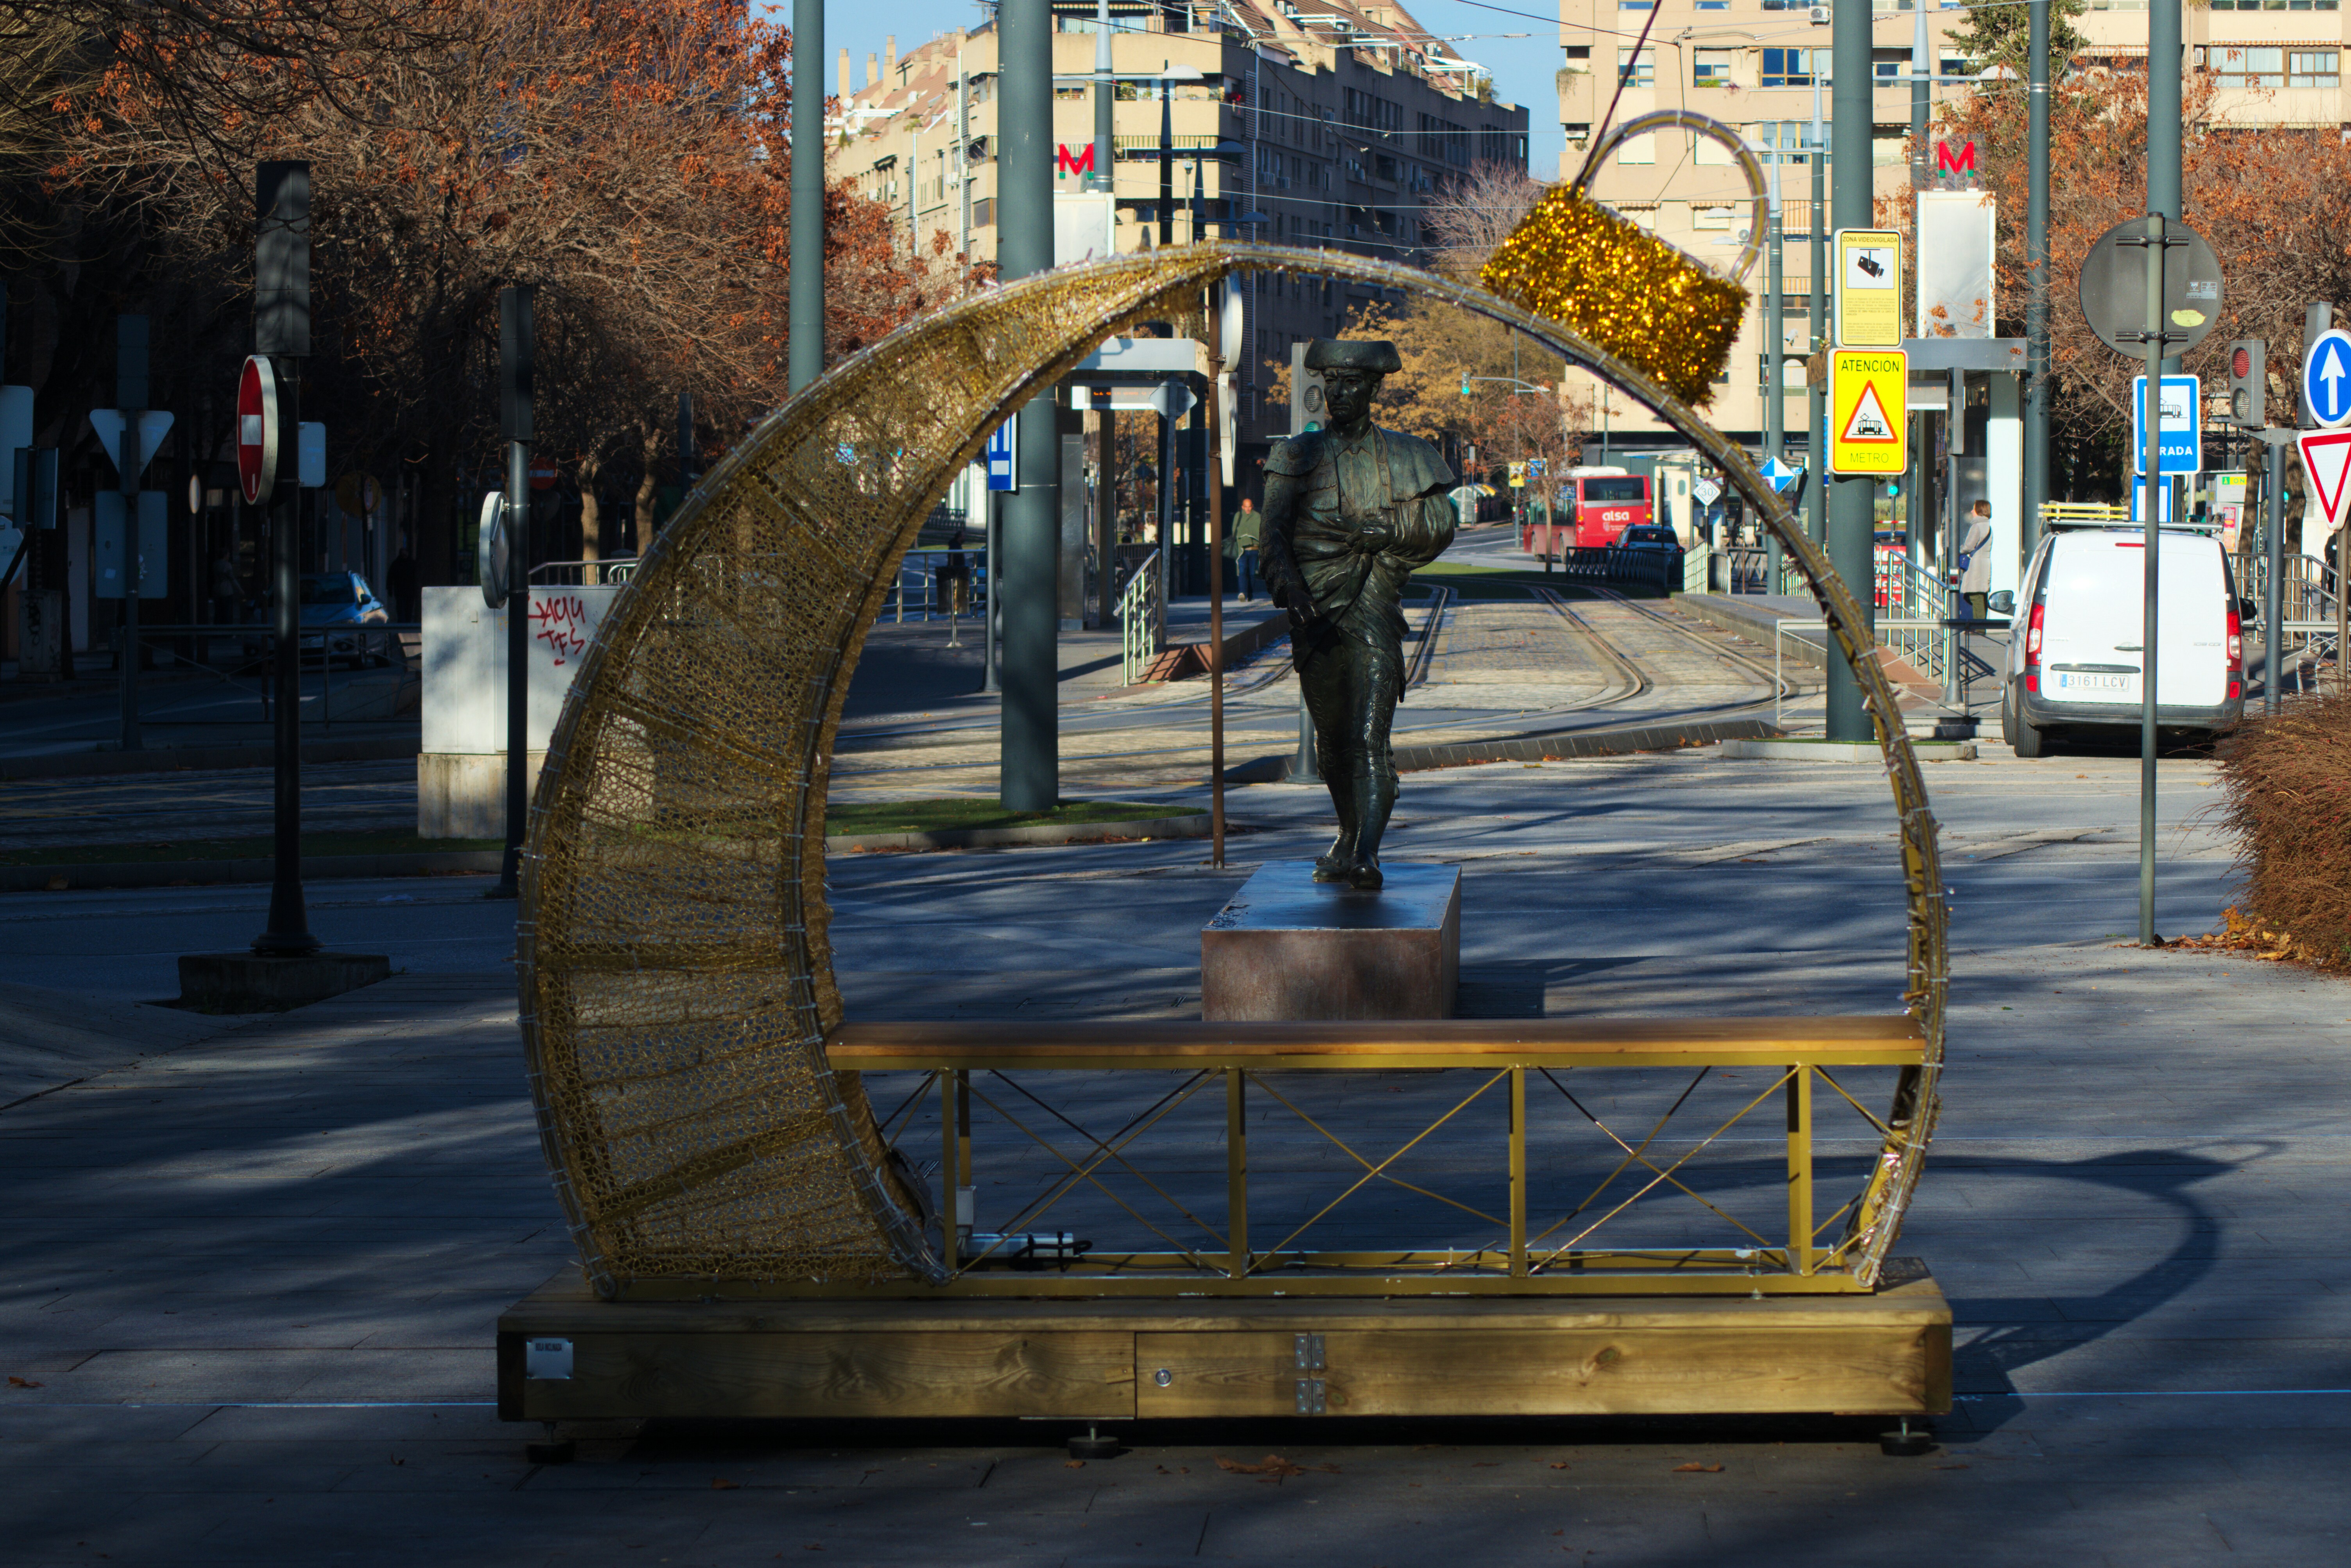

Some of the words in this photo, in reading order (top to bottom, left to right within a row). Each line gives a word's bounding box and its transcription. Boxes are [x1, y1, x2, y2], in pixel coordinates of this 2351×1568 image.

[1059, 143, 1094, 179] M
[1939, 141, 1974, 177] M
[1841, 357, 1899, 372] ATENCIÓN
[2143, 446, 2193, 456] RADA
[1851, 453, 1889, 463] METRO
[1701, 488, 1713, 496] 30
[1602, 510, 1629, 521] alsa
[2068, 675, 2097, 687] 3161
[2103, 676, 2125, 687] LCV
